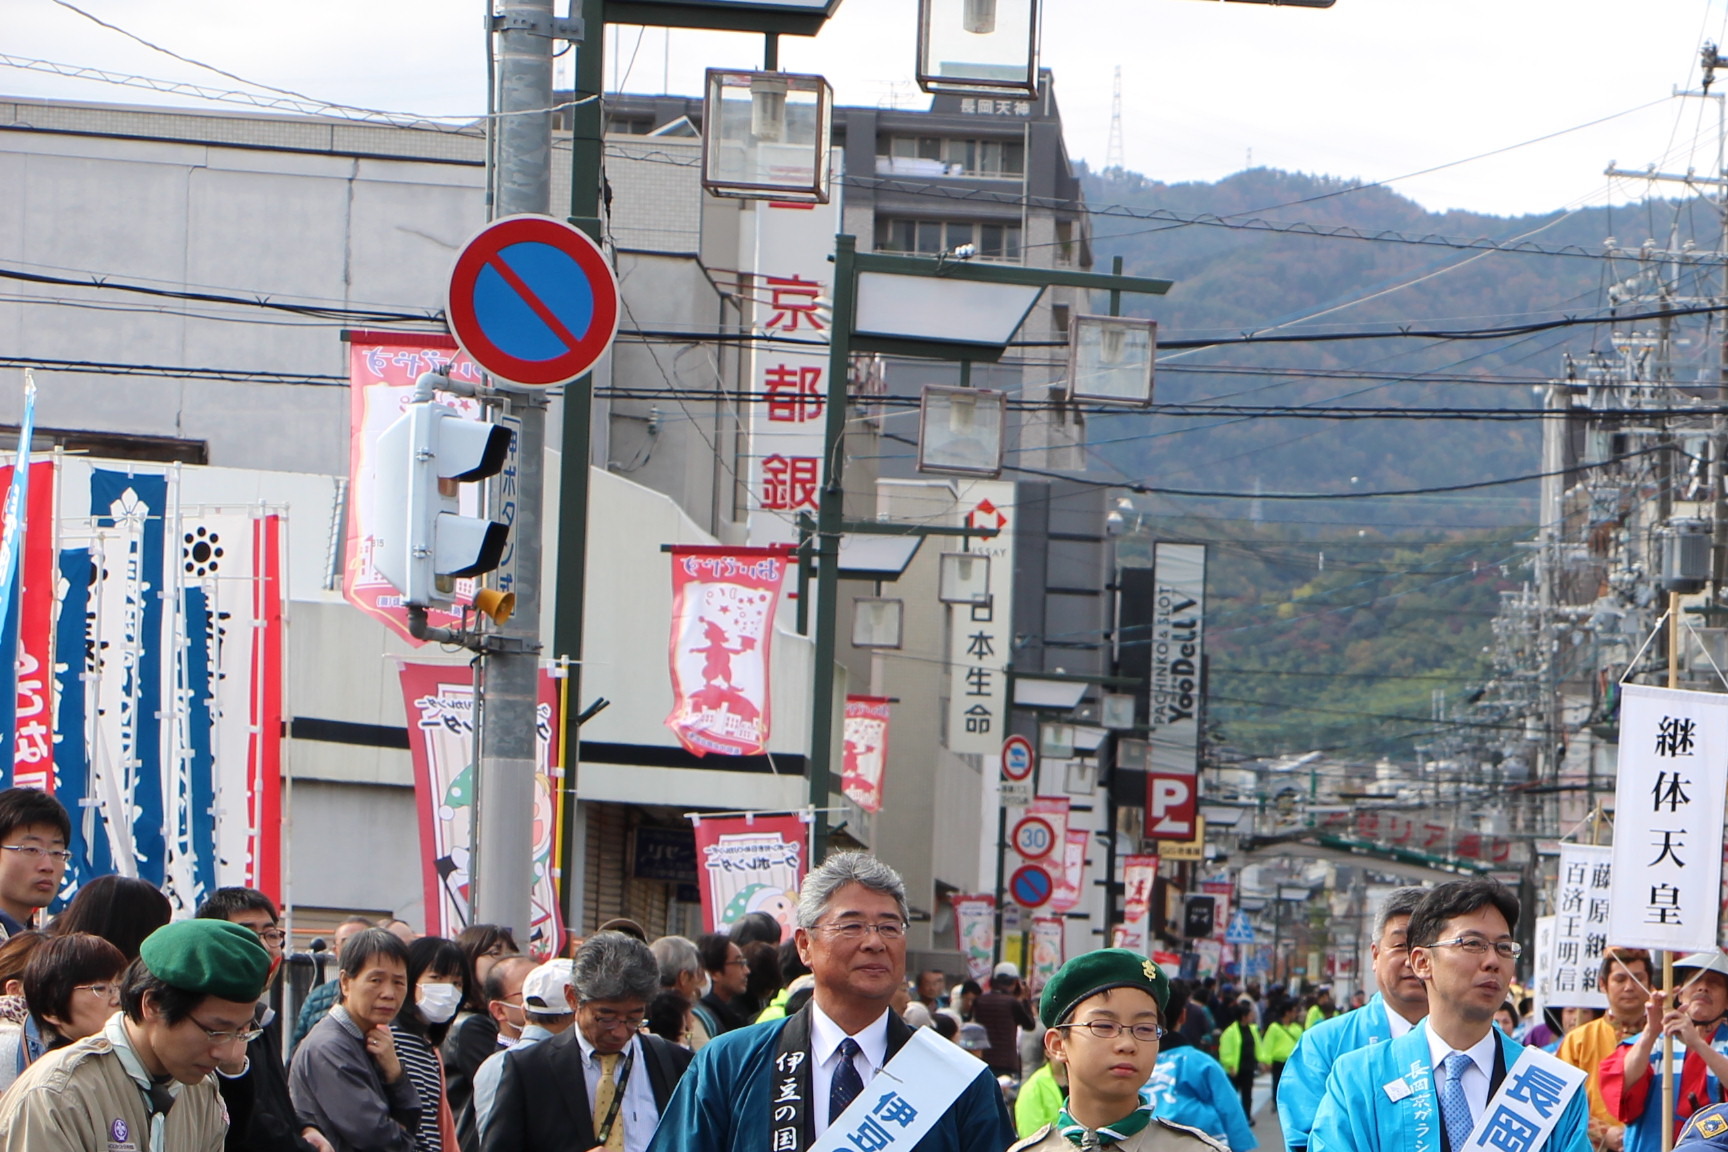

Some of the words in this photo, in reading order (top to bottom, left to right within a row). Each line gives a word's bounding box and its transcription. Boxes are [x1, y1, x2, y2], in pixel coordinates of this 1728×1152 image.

[760, 274, 824, 512] 京都銀
[968, 547, 1007, 558] ISSAY
[1157, 584, 1171, 626] SLOT
[964, 594, 995, 735] 日本生命
[1154, 651, 1169, 724] PACHINKO
[1021, 828, 1047, 849] 30
[1152, 779, 1189, 818] P
[1643, 715, 1697, 926] 継体天皇
[1556, 861, 1588, 993] 百済王明信
[773, 1051, 805, 1152] 伊豆の国
